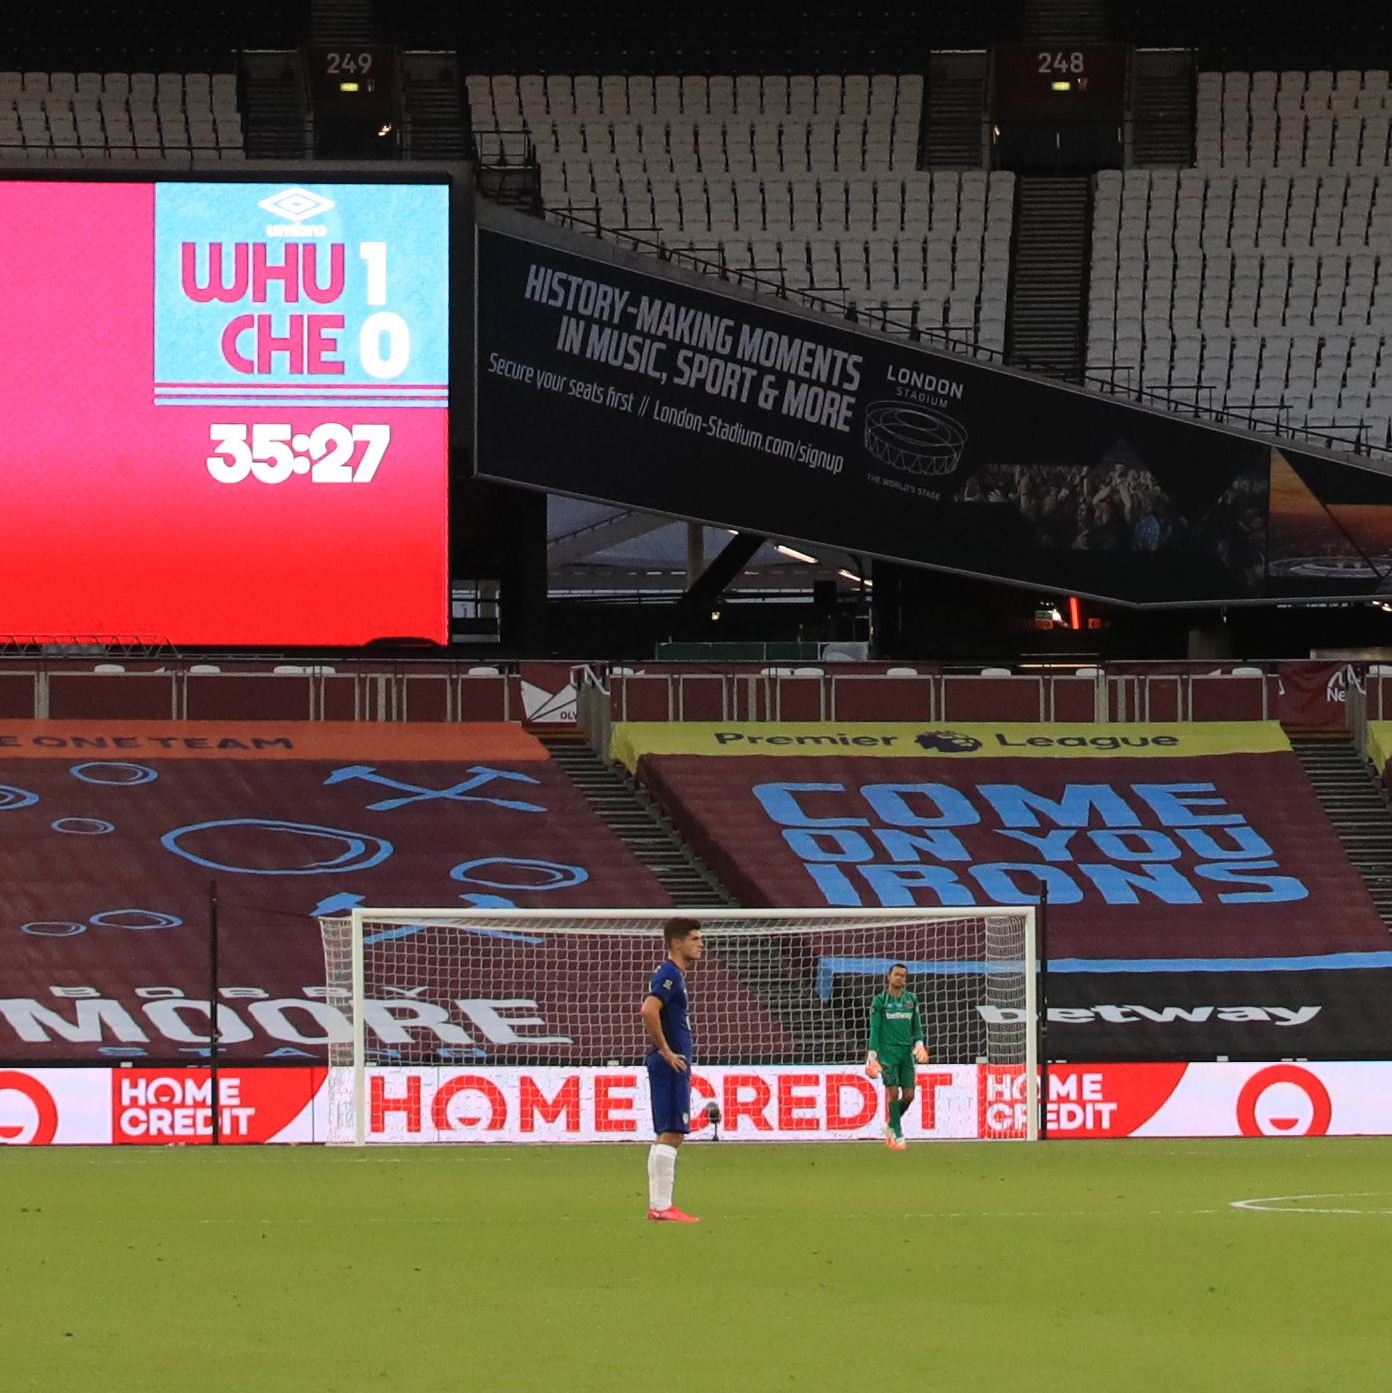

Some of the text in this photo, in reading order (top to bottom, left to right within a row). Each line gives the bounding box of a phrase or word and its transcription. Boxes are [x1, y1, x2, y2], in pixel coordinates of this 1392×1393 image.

[326, 53, 372, 76] 249
[1038, 52, 1086, 75] 248
[265, 222, 327, 237] umbro
[181, 241, 388, 306] WHU 1
[221, 311, 410, 379] CHE 0
[525, 264, 863, 391] HISTORY-MAKING MOMENTS
[556, 315, 856, 433] IN MUSIC, SPORT & MORE
[887, 364, 964, 400] LONDON
[488, 352, 534, 384] Secure
[536, 368, 567, 392] your
[568, 376, 605, 403] seats
[606, 385, 635, 413] first
[653, 398, 844, 475] London-Stadium.com/signup
[896, 386, 948, 408] STADIUM
[207, 423, 391, 484] 35:27
[32, 736, 144, 749] ONE
[147, 736, 295, 750] TEAM
[714, 730, 1180, 750] Premier League
[752, 782, 1247, 829] COME
[781, 826, 1276, 863] ON YOU
[803, 860, 1311, 907] IRONS
[976, 1004, 1322, 1026] betway
[121, 1077, 242, 1107] HOME
[370, 1073, 953, 1133] HOME REDT
[119, 1107, 256, 1138] CREDIT
